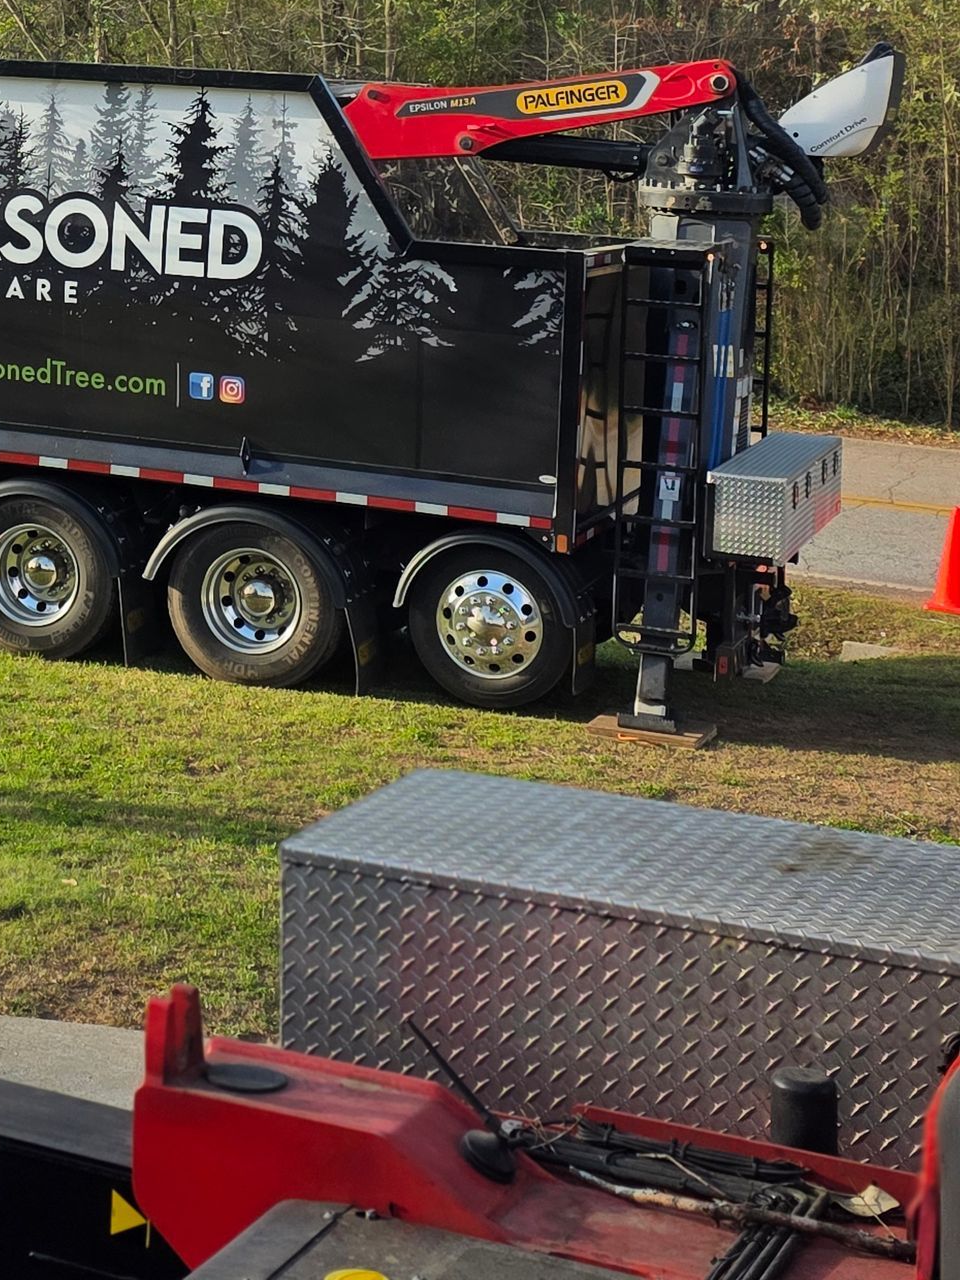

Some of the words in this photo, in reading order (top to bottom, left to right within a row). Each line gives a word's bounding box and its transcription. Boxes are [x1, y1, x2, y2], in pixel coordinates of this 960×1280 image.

[409, 100, 448, 113] EPSILON
[450, 96, 477, 109] M13A
[523, 84, 620, 110] PALFINGER
[809, 129, 846, 153] Comfort
[844, 117, 868, 133] Drive
